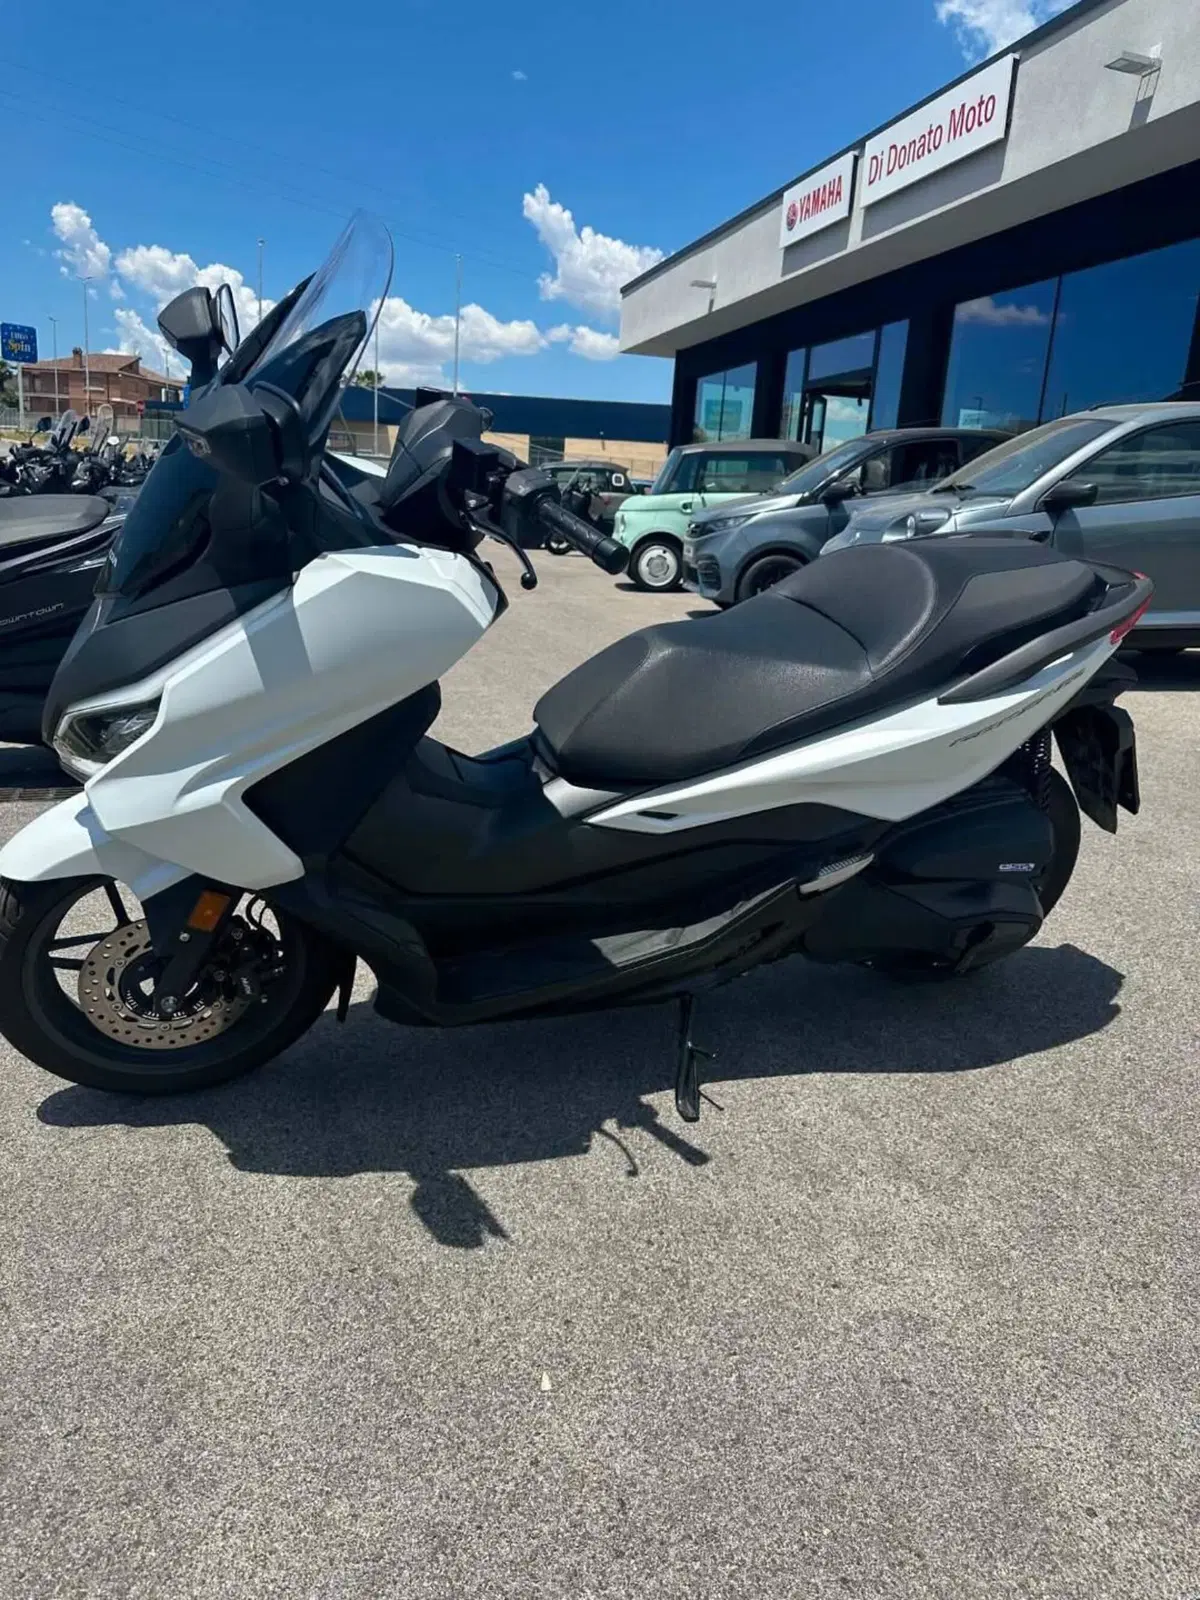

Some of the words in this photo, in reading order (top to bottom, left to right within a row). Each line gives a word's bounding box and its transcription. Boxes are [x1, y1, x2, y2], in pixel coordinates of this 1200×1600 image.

[868, 150, 884, 186] Di
[886, 123, 943, 176] Donato
[947, 94, 996, 143] Moto
[799, 175, 843, 223] YAMAHA
